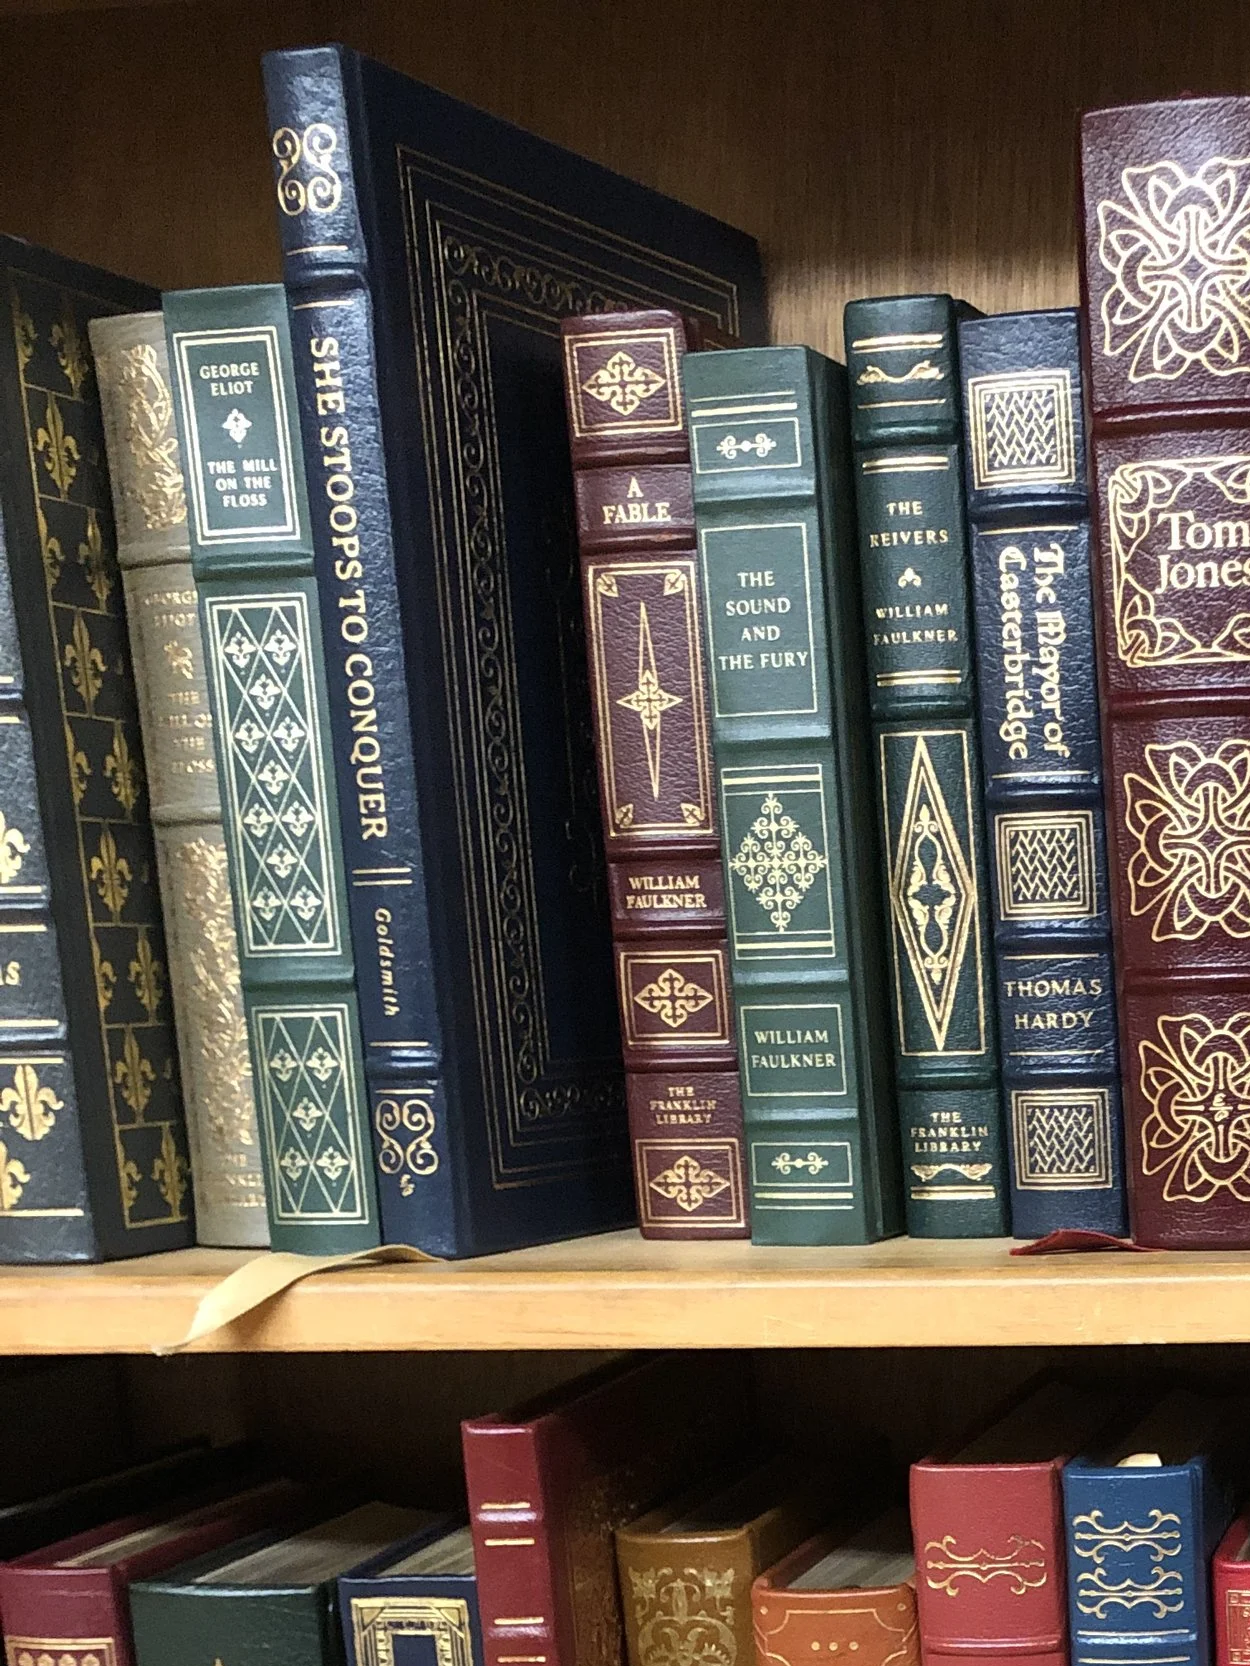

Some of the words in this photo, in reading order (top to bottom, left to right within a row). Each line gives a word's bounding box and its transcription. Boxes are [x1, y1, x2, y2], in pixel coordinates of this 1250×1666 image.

[200, 362, 260, 379] GEORGE
[309, 337, 345, 415] SHE
[210, 381, 254, 396] ELIOT
[207, 460, 235, 474] THE
[242, 458, 277, 473] MILL
[215, 477, 239, 491] ON
[244, 476, 271, 491] THE
[627, 476, 644, 498] A
[222, 493, 267, 508] FLOSS
[320, 426, 363, 582] STOOPS
[886, 500, 923, 516] THE
[602, 502, 672, 524] FABLE
[870, 529, 949, 547] REIVERS
[737, 571, 775, 587] THE
[1034, 543, 1065, 604] The
[725, 597, 791, 616] SOUND
[876, 604, 949, 619] WILLIAM
[338, 589, 368, 644] TO
[741, 625, 780, 642] AND
[873, 629, 958, 645] FAULKNER
[718, 655, 754, 670] THE
[760, 651, 808, 668] FURY
[999, 547, 1035, 760] Casterbridge
[1032, 610, 1067, 722] Mayor
[345, 653, 388, 840] CONQUER
[1043, 727, 1071, 758] of
[628, 876, 700, 890] WILLIAM
[626, 894, 707, 909] FAULKNER
[375, 907, 401, 1017] Goldsmith
[1004, 978, 1102, 997] THOMAS
[1015, 1012, 1093, 1030] HARDY
[754, 1029, 829, 1044] WILLIAM
[751, 1054, 836, 1068] FAULKNER
[668, 1087, 695, 1097] THE
[650, 1099, 717, 1111] FRANKLIN
[656, 1113, 712, 1124] LIBRARY
[930, 1112, 962, 1123] THE
[911, 1126, 989, 1138] FRANKLIN
[914, 1141, 981, 1153] LIBRARY
